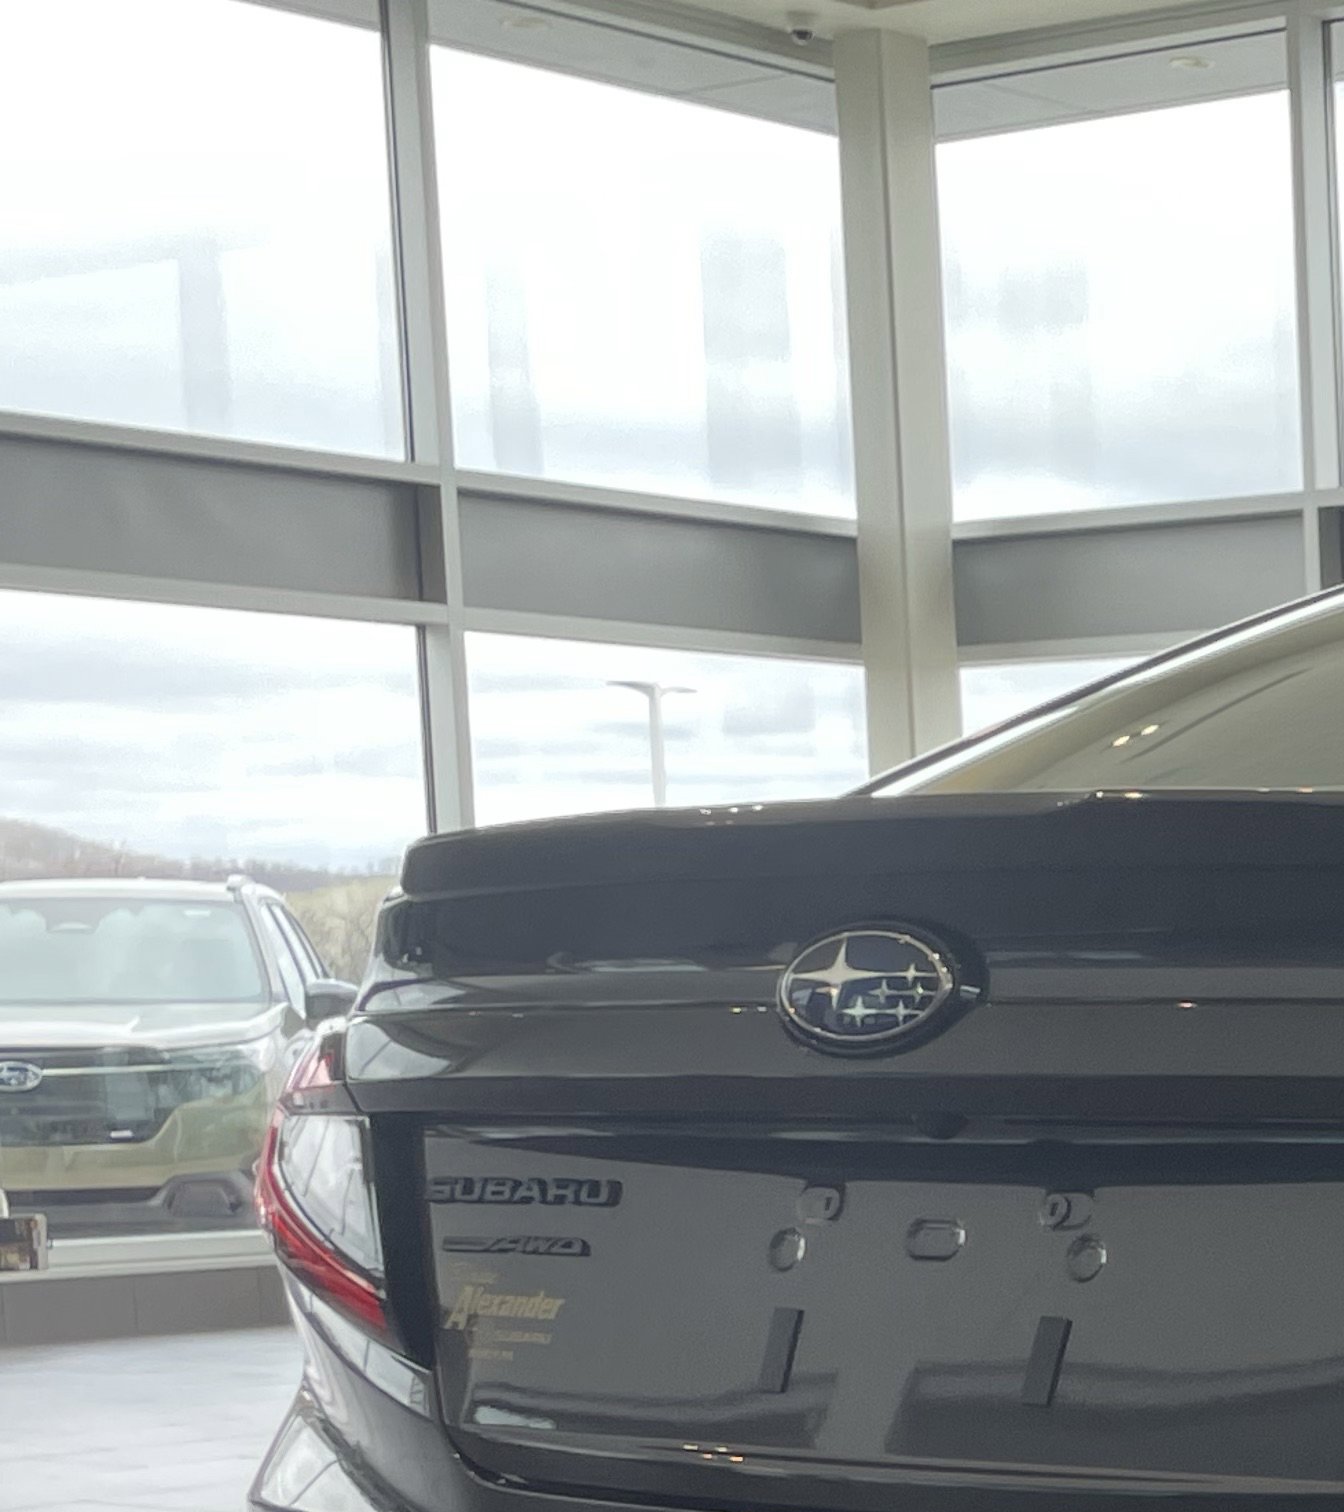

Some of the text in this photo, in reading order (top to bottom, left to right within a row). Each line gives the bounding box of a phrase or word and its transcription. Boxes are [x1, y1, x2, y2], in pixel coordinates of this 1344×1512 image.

[428, 1176, 623, 1207] SUBARU
[489, 1235, 592, 1257] AWD
[441, 1284, 566, 1331] Alexander
